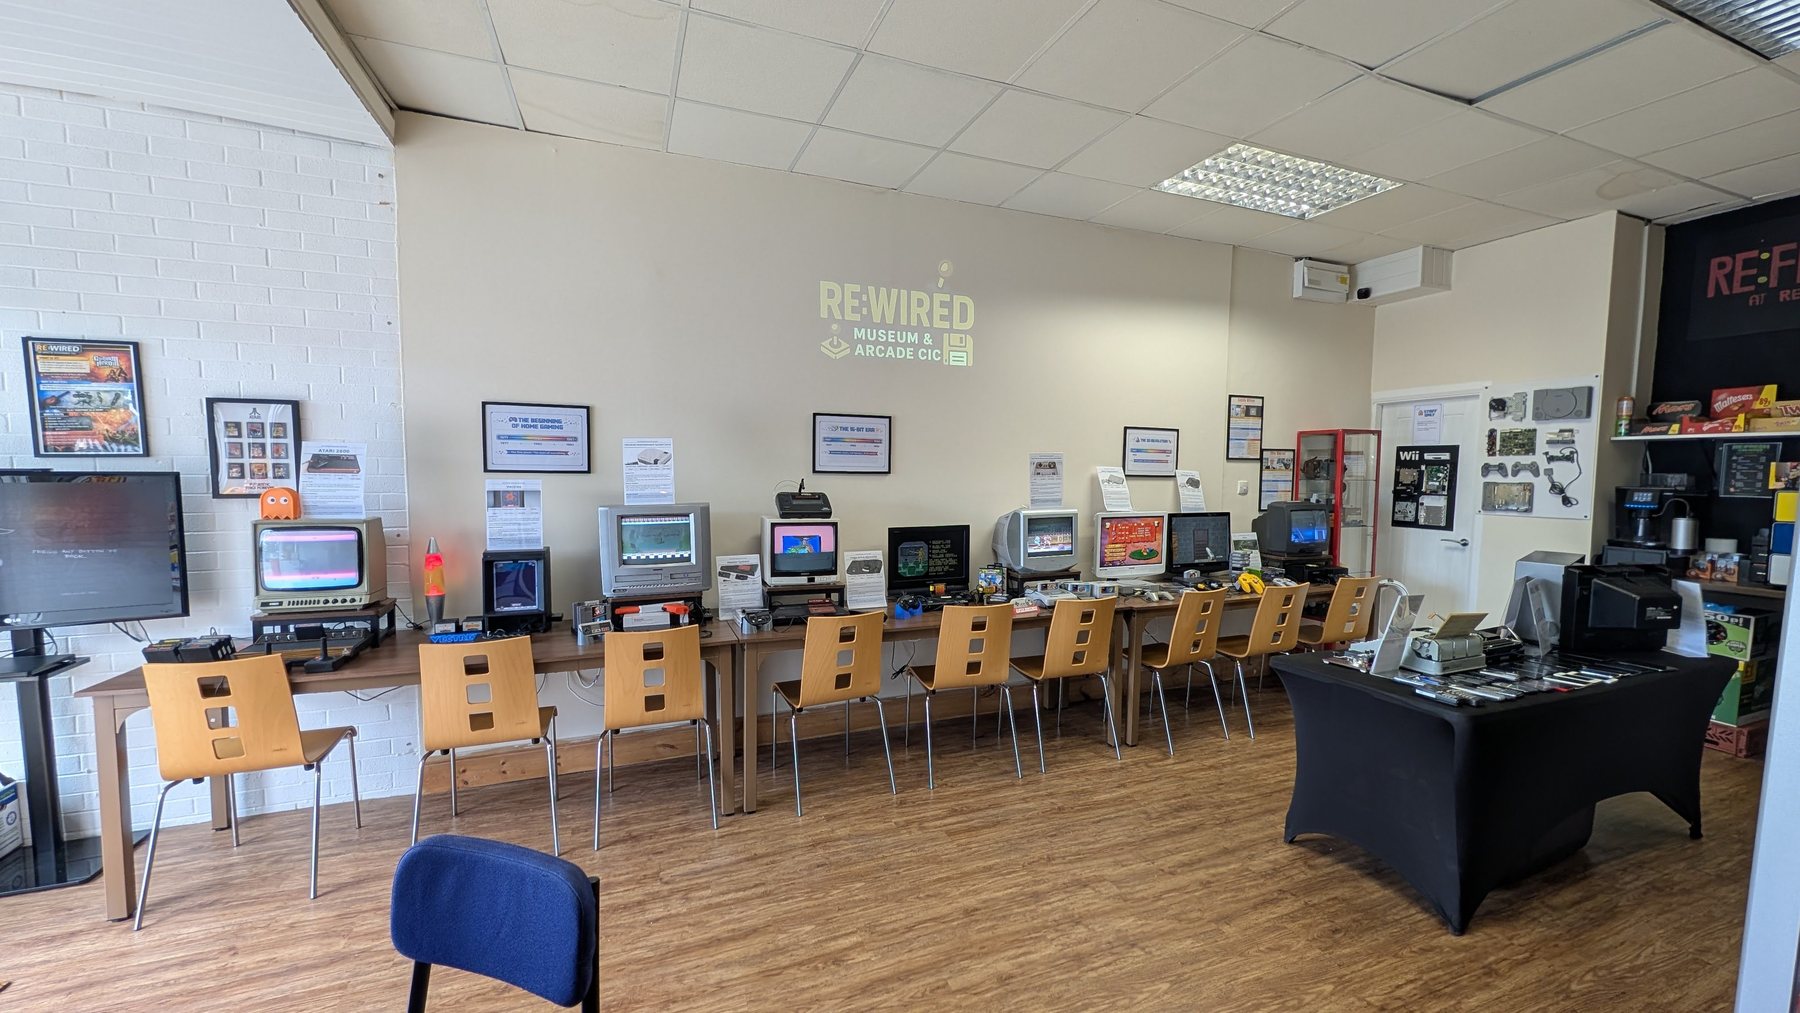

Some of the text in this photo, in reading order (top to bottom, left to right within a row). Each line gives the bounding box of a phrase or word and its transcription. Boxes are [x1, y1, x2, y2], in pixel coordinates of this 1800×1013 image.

[1707, 242, 1800, 298] RE:F
[819, 280, 975, 330] RE:WIRED
[1749, 293, 1766, 306] AT
[853, 327, 933, 345] MUSEUM &
[854, 343, 942, 361] ARCADE CIC
[1714, 394, 1753, 413] Maltesers
[1399, 450, 1420, 461] Wii
